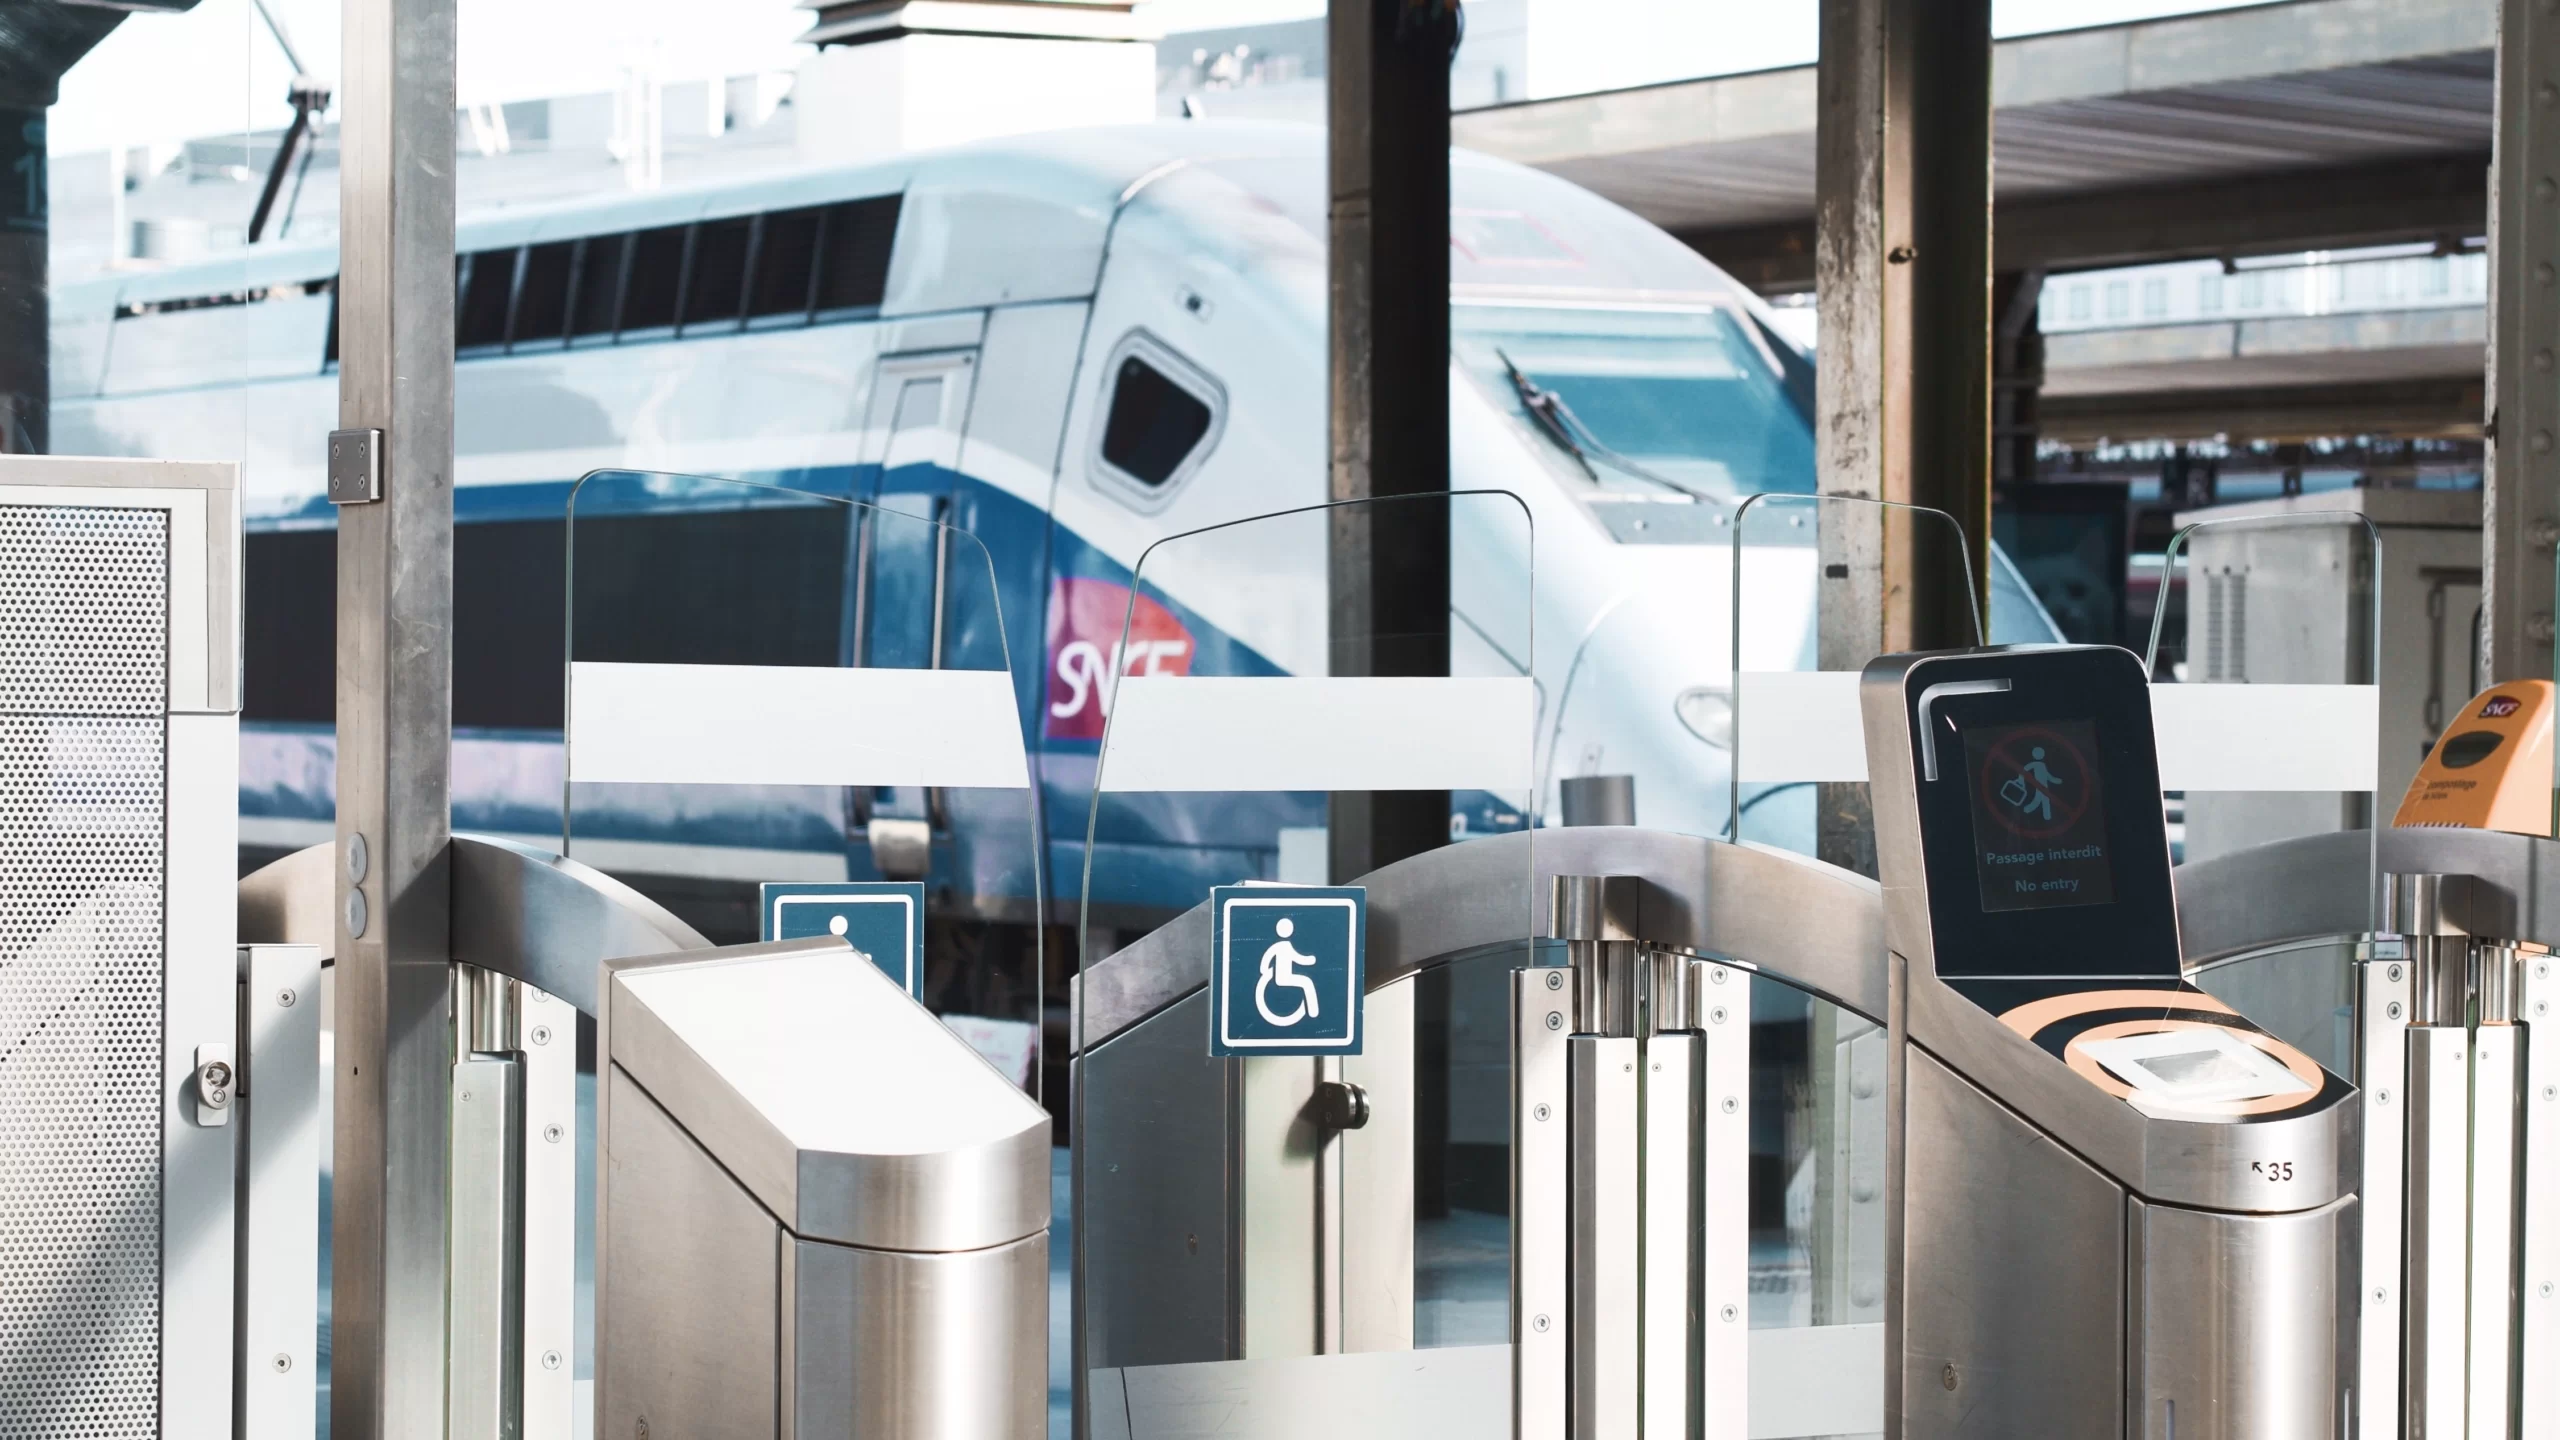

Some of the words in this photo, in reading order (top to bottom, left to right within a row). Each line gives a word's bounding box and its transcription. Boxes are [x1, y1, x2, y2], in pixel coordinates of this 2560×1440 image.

[2480, 702, 2520, 717] SNCF
[1986, 852, 2044, 865] Passage
[2048, 845, 2102, 860] interdit
[2015, 880, 2037, 893] No
[2041, 879, 2079, 892] entry
[2268, 1162, 2293, 1182] 35
